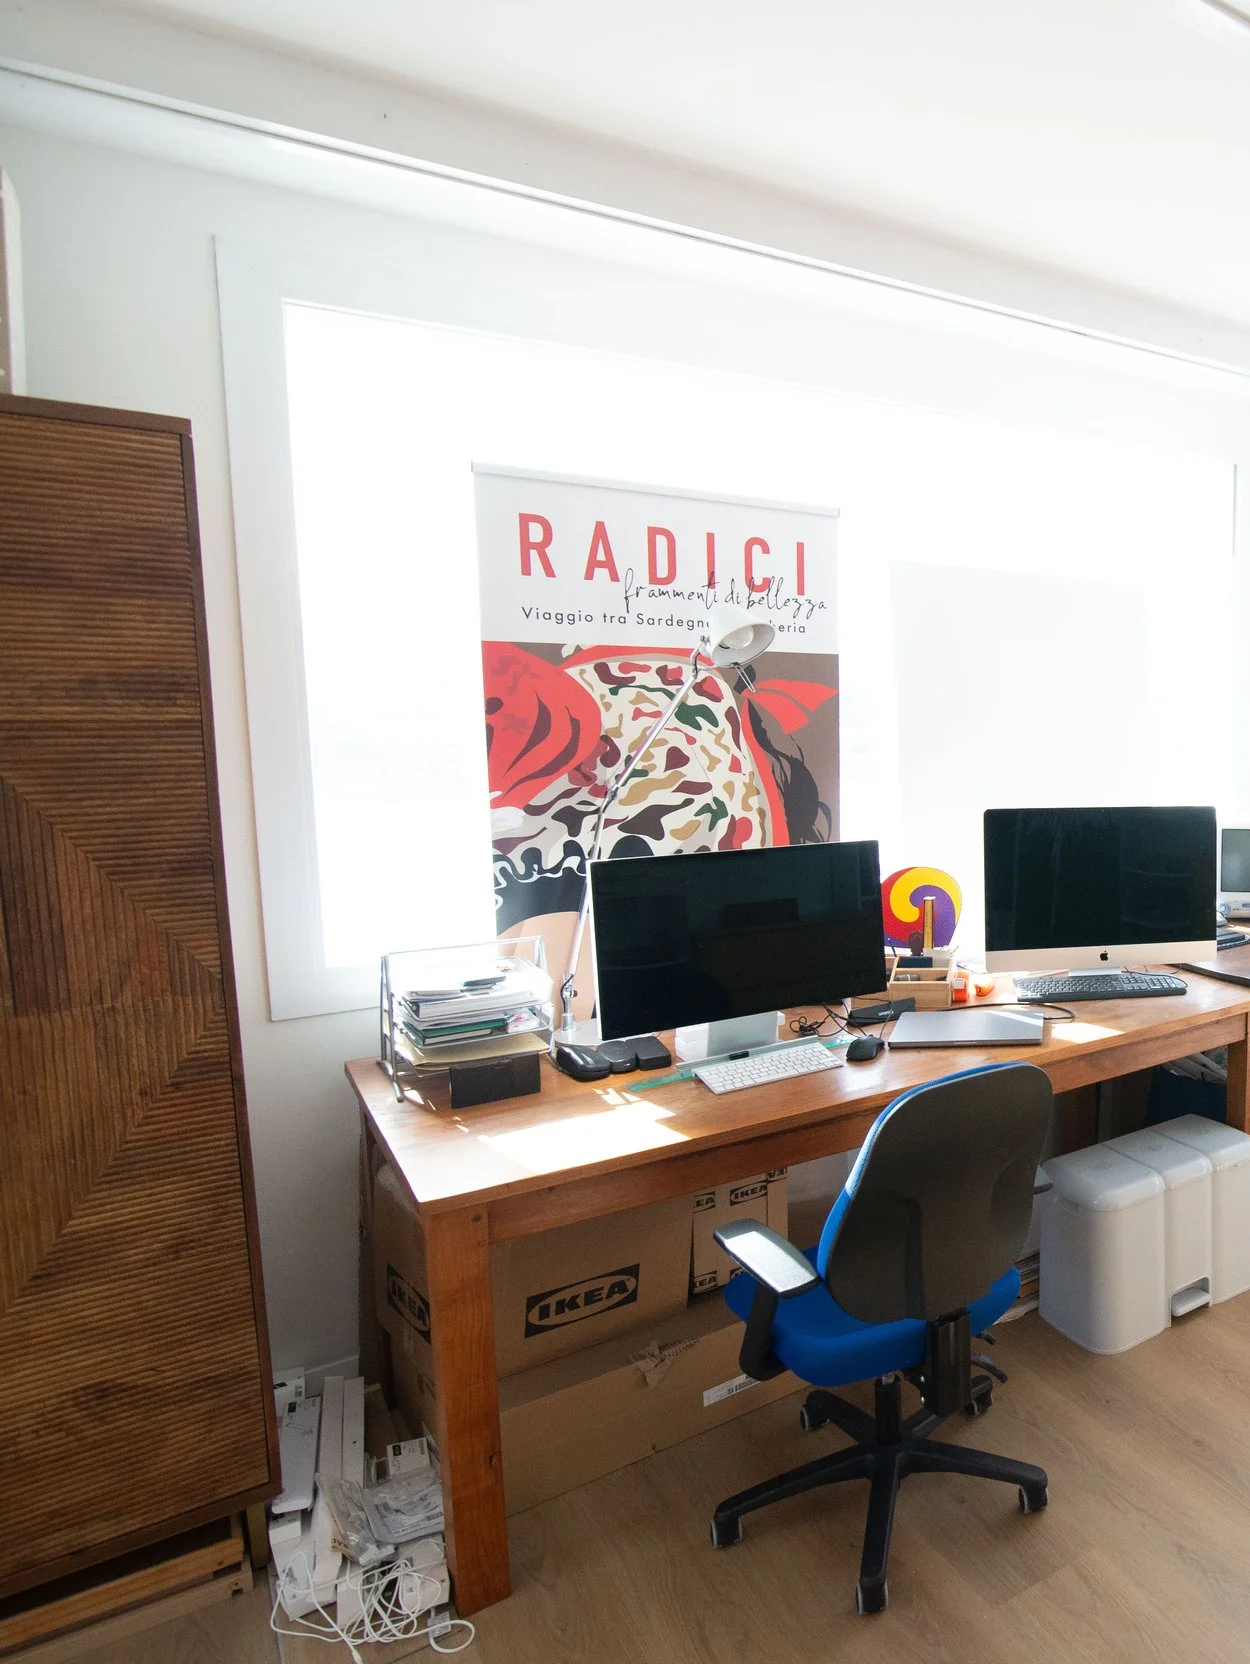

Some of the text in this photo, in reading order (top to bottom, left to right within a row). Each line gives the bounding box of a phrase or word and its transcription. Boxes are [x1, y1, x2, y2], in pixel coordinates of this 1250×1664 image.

[518, 512, 806, 596] RADICI
[623, 567, 829, 620] frammenti di bellezza
[521, 606, 594, 626] Viaggio
[603, 612, 628, 625] tra
[636, 612, 710, 631] Sardegn
[734, 1184, 768, 1200] IKEA
[538, 1279, 630, 1321] IKEA
